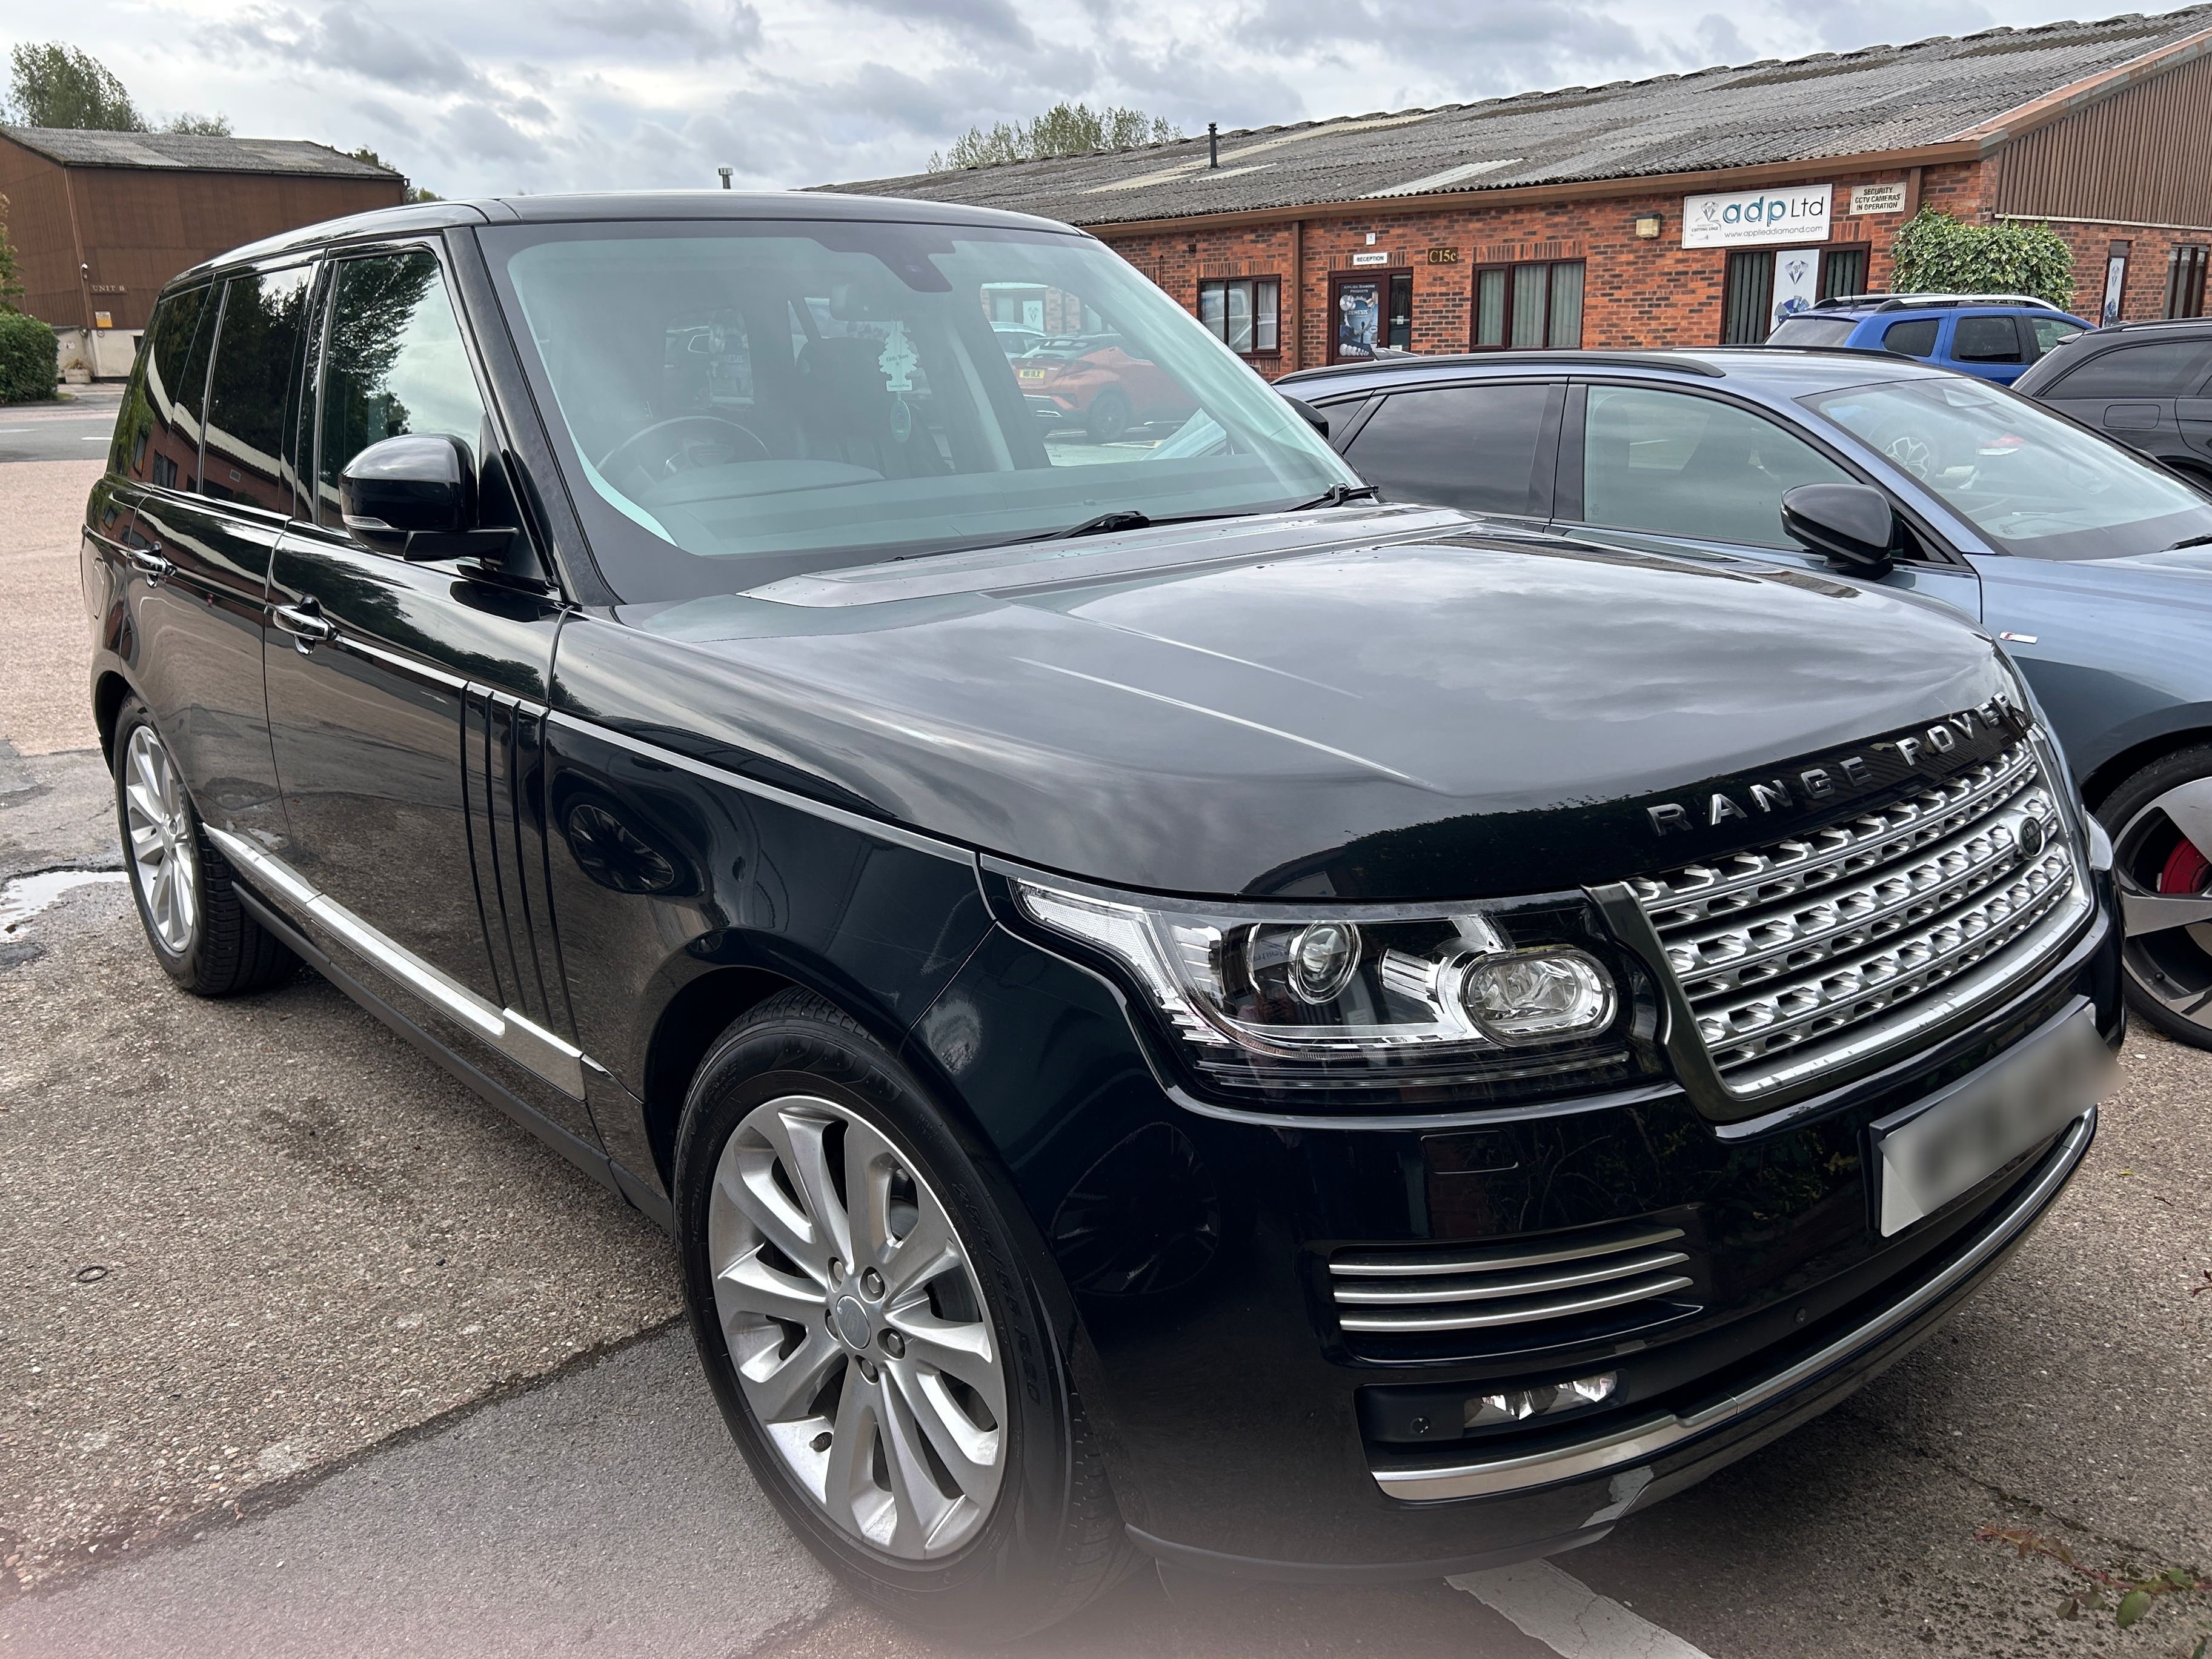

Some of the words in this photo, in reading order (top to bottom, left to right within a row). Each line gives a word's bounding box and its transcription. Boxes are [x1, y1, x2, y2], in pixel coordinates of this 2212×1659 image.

[1863, 187, 1893, 195] SECURITY
[1871, 194, 1901, 202] CAMERAS
[1722, 196, 1786, 227] adp
[1791, 196, 1824, 218] Ltd
[1864, 202, 1898, 210] OPERATION
[1724, 225, 1822, 238] www.applieddiamond.com
[1429, 250, 1456, 263] C15c
[1645, 756, 1874, 837] RANGE
[1895, 691, 2027, 766] ROVER
